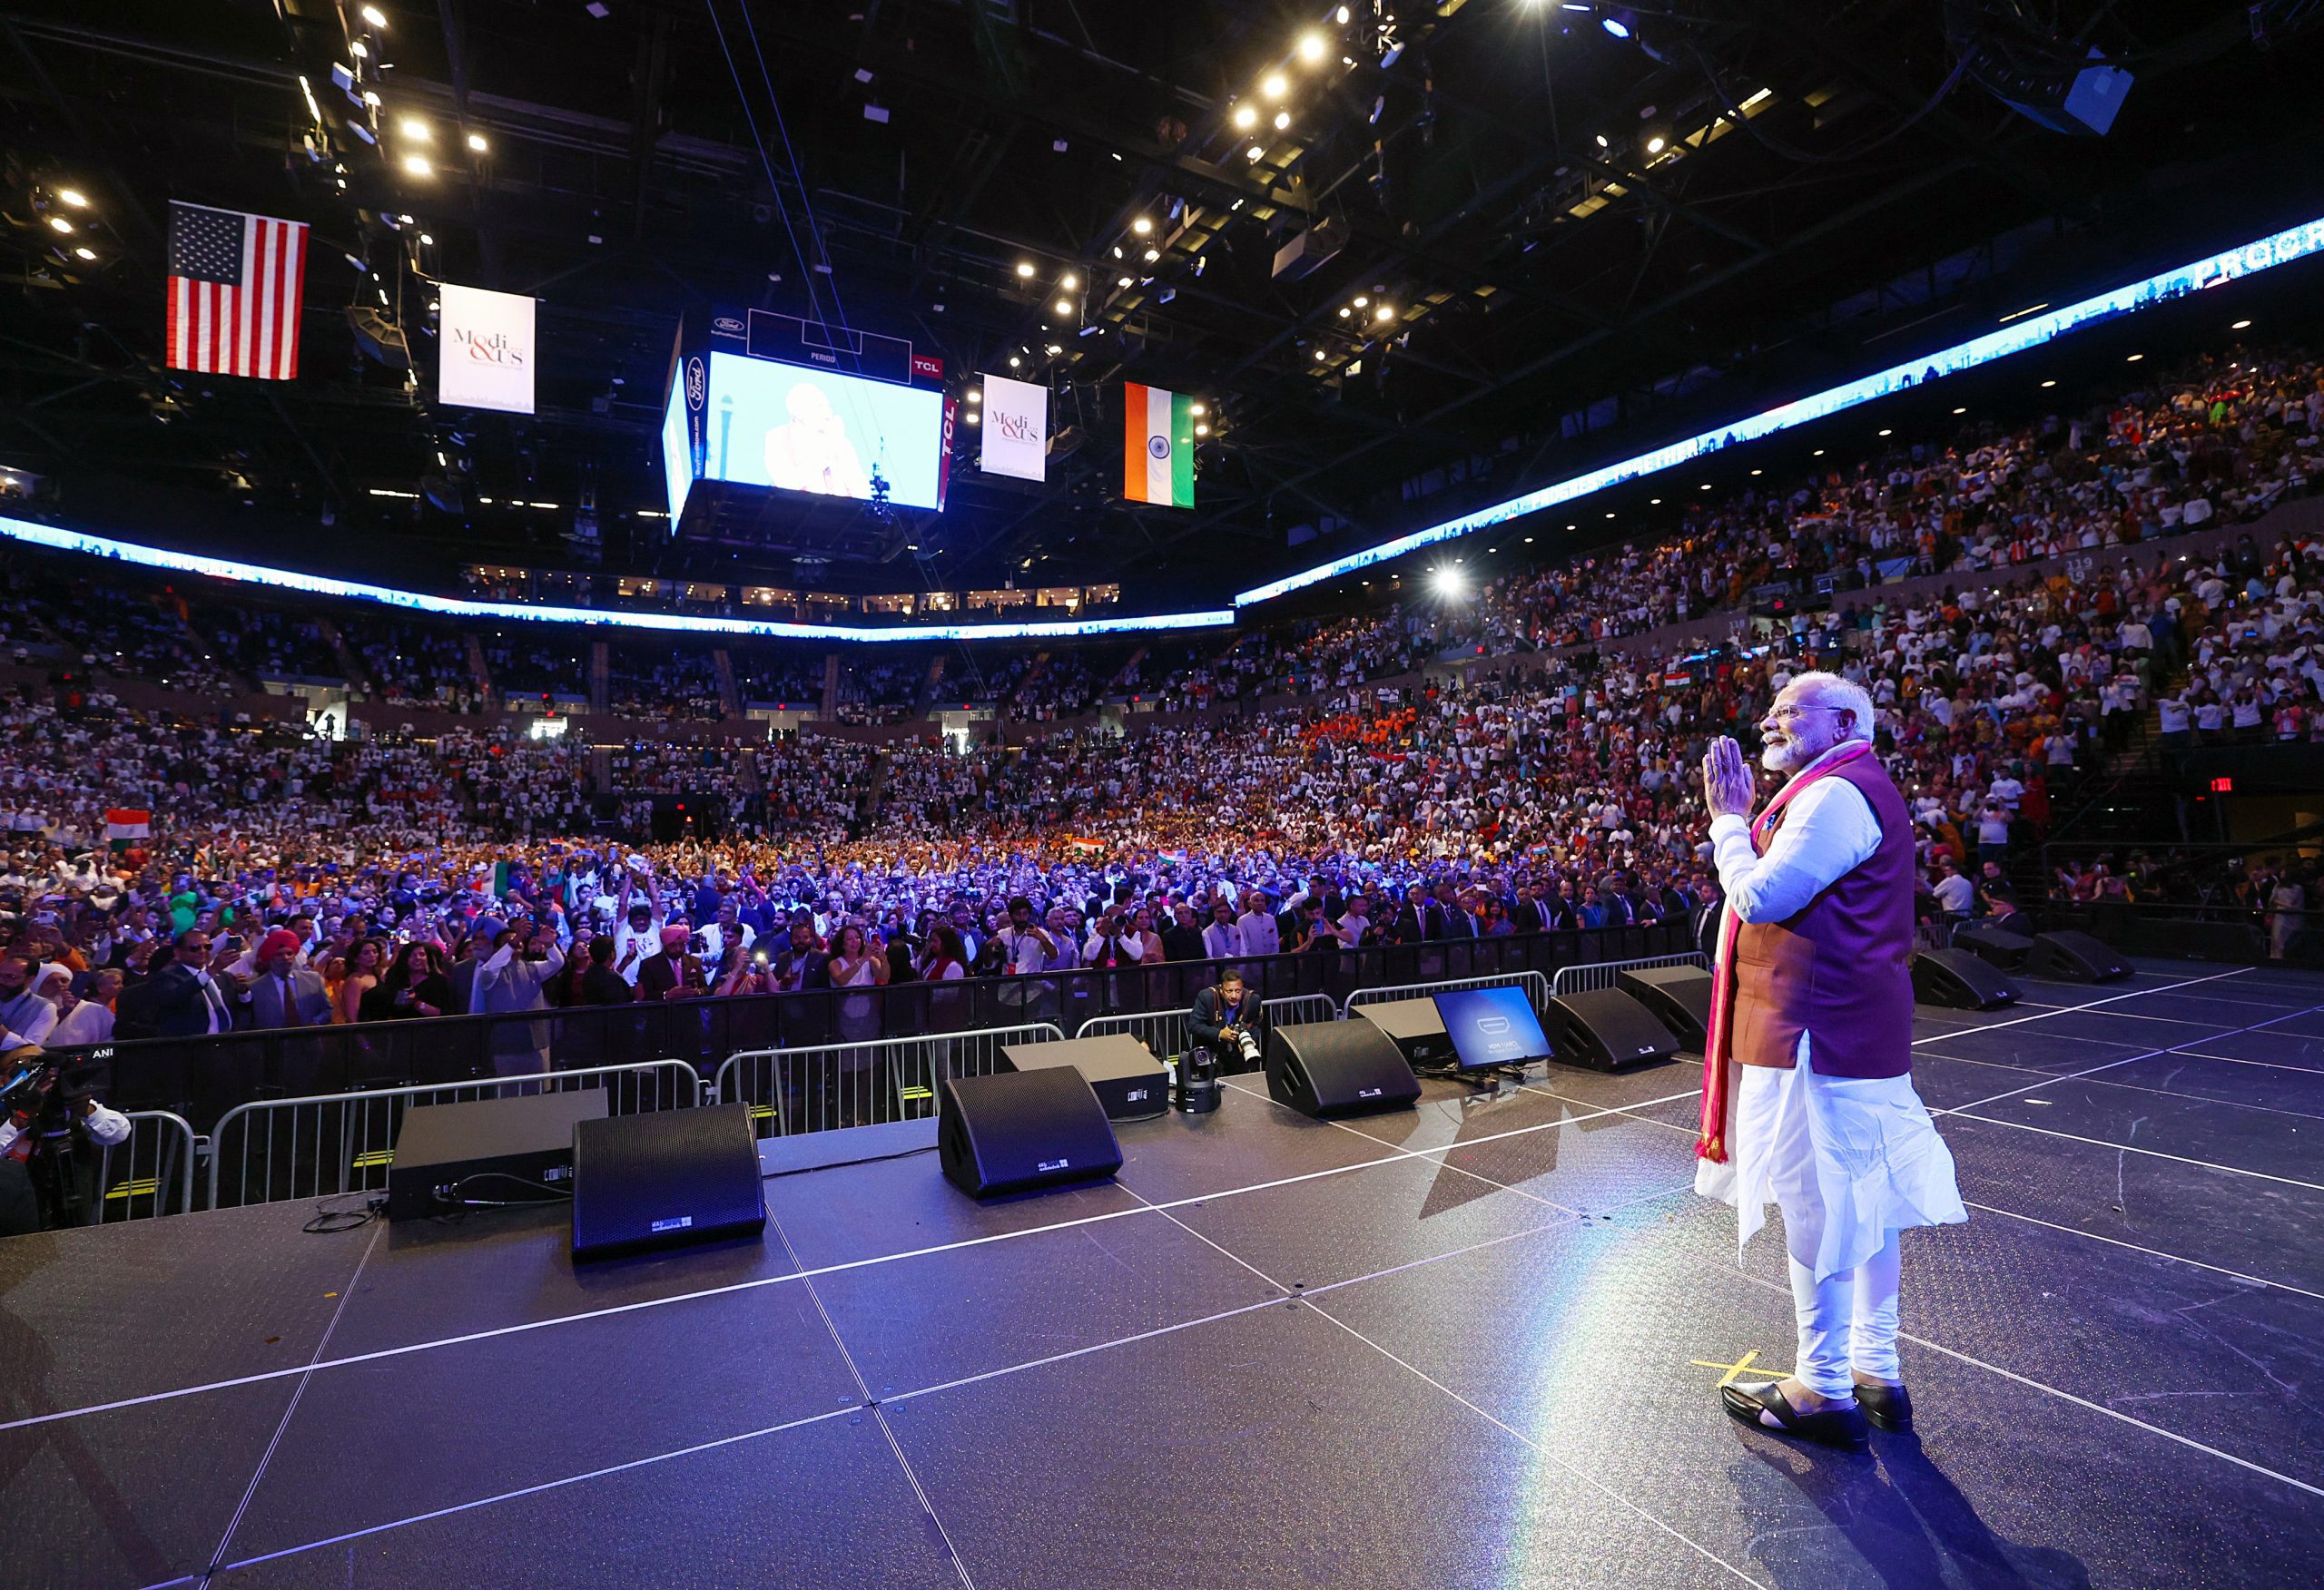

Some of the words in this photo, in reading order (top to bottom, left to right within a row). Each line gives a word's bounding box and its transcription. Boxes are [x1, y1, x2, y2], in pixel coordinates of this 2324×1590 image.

[454, 328, 507, 349] Modi
[811, 351, 835, 363] PERIOD
[914, 360, 940, 373] TCL
[689, 367, 702, 401] Ford
[991, 411, 1028, 428] Modi
[941, 406, 955, 456] TCL
[2065, 557, 2093, 570] 119
[93, 1047, 113, 1059] ANI
